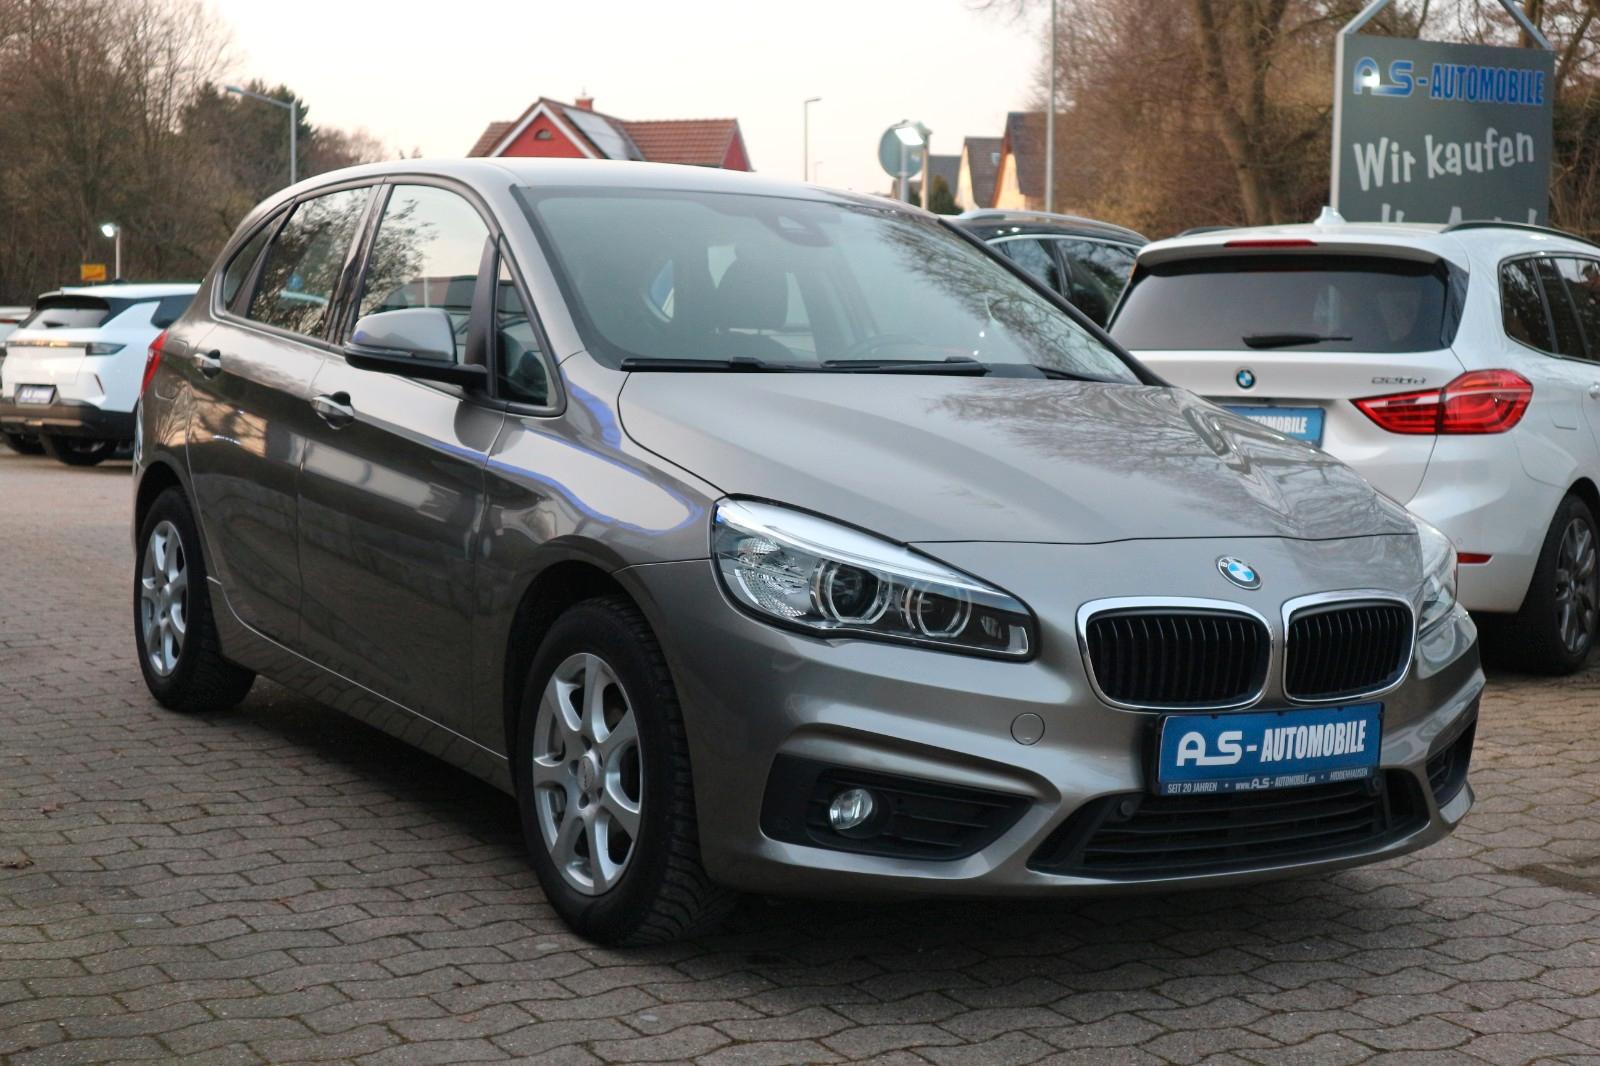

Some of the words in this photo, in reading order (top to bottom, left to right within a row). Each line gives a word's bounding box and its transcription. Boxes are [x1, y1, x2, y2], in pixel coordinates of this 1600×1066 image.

[1353, 137, 1416, 191] Wir
[1425, 127, 1535, 179] kaufen
[1167, 783, 1181, 793] SEIT
[1182, 782, 1192, 793] 20
[1192, 781, 1218, 792] JAHREN
